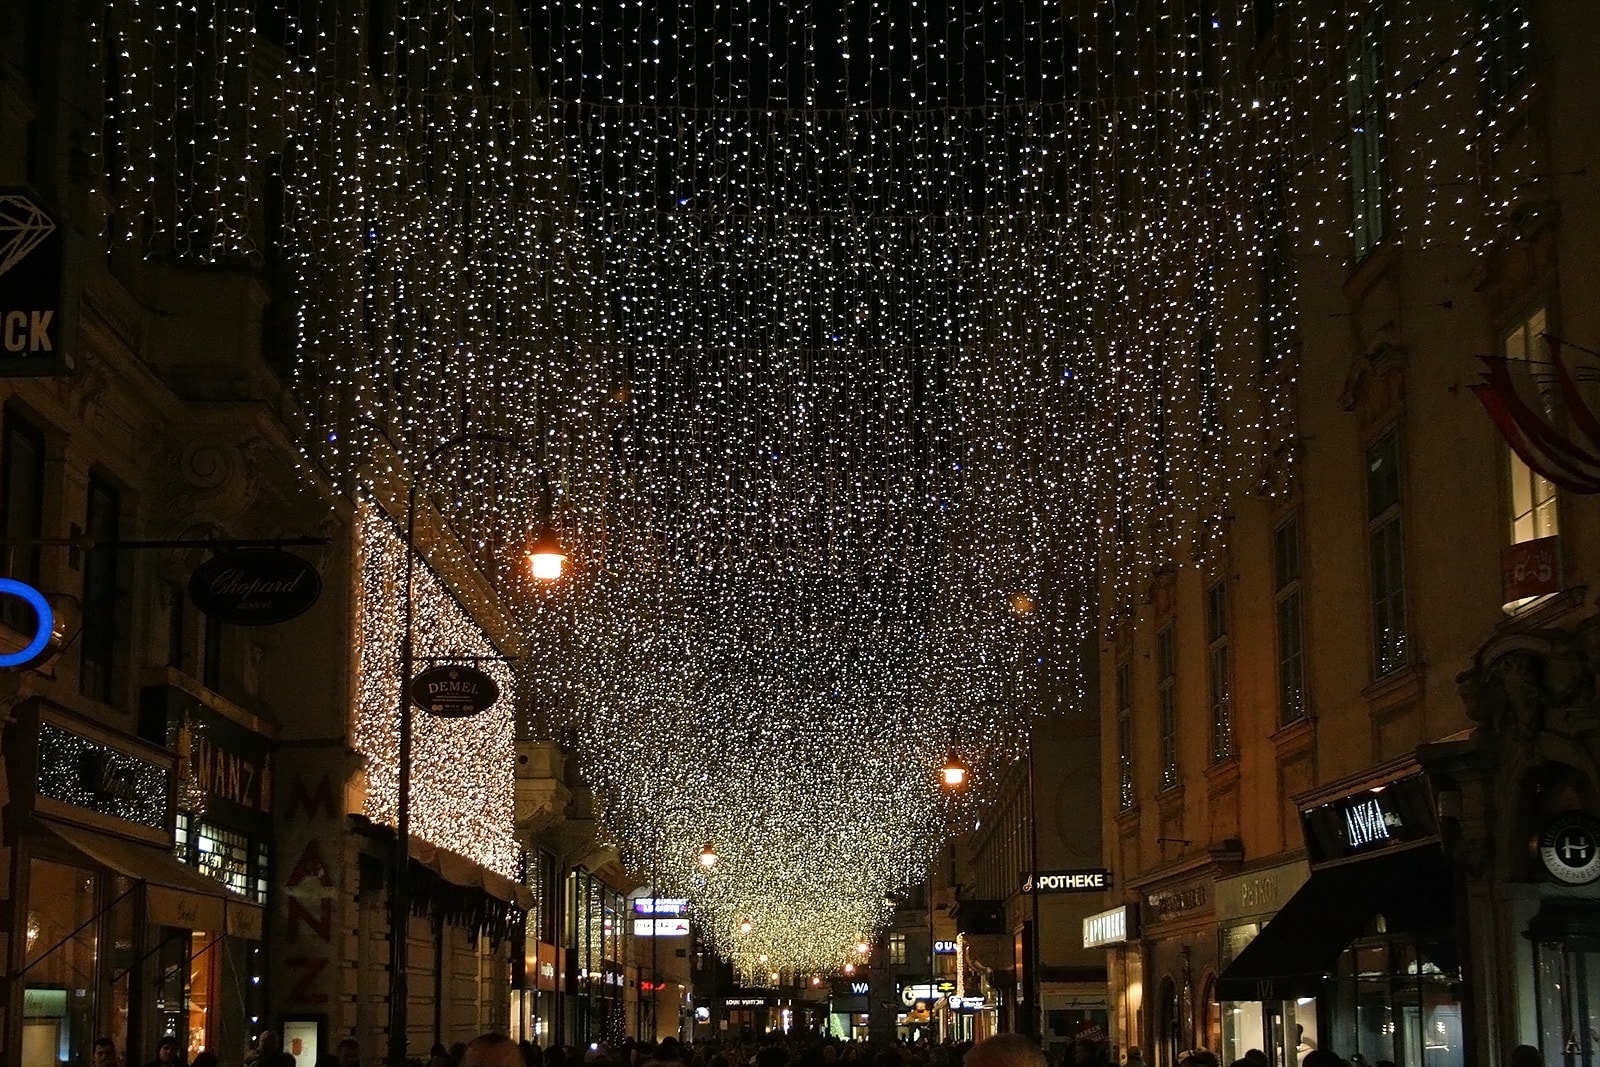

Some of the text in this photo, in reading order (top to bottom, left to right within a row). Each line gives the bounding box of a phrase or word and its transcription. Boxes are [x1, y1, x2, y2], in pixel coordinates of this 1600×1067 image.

[0, 310, 54, 352] CK
[210, 568, 307, 600] Chopard
[428, 681, 479, 695] DEMEL
[199, 740, 255, 808] MANZ
[284, 773, 336, 1002] MANZ
